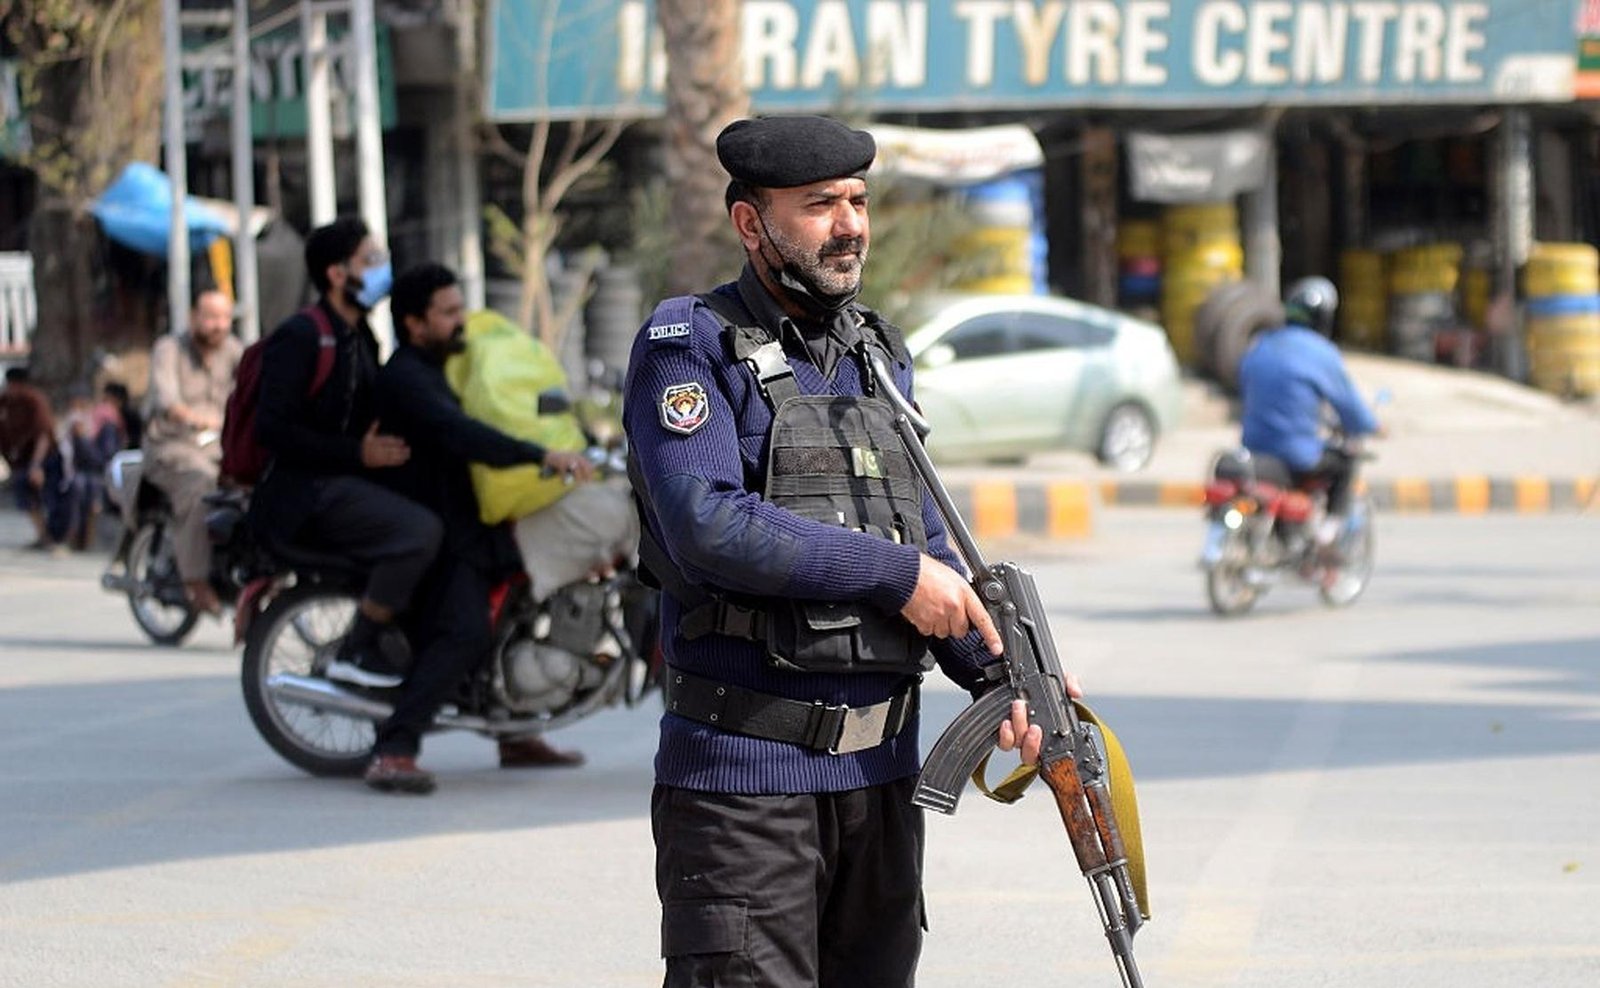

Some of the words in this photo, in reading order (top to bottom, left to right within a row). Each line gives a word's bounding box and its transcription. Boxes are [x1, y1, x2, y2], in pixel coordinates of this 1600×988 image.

[617, 0, 926, 91] IRAN
[954, 0, 1169, 86] TYRE
[1193, 0, 1488, 83] CENTRE
[648, 322, 690, 340] POLICE
